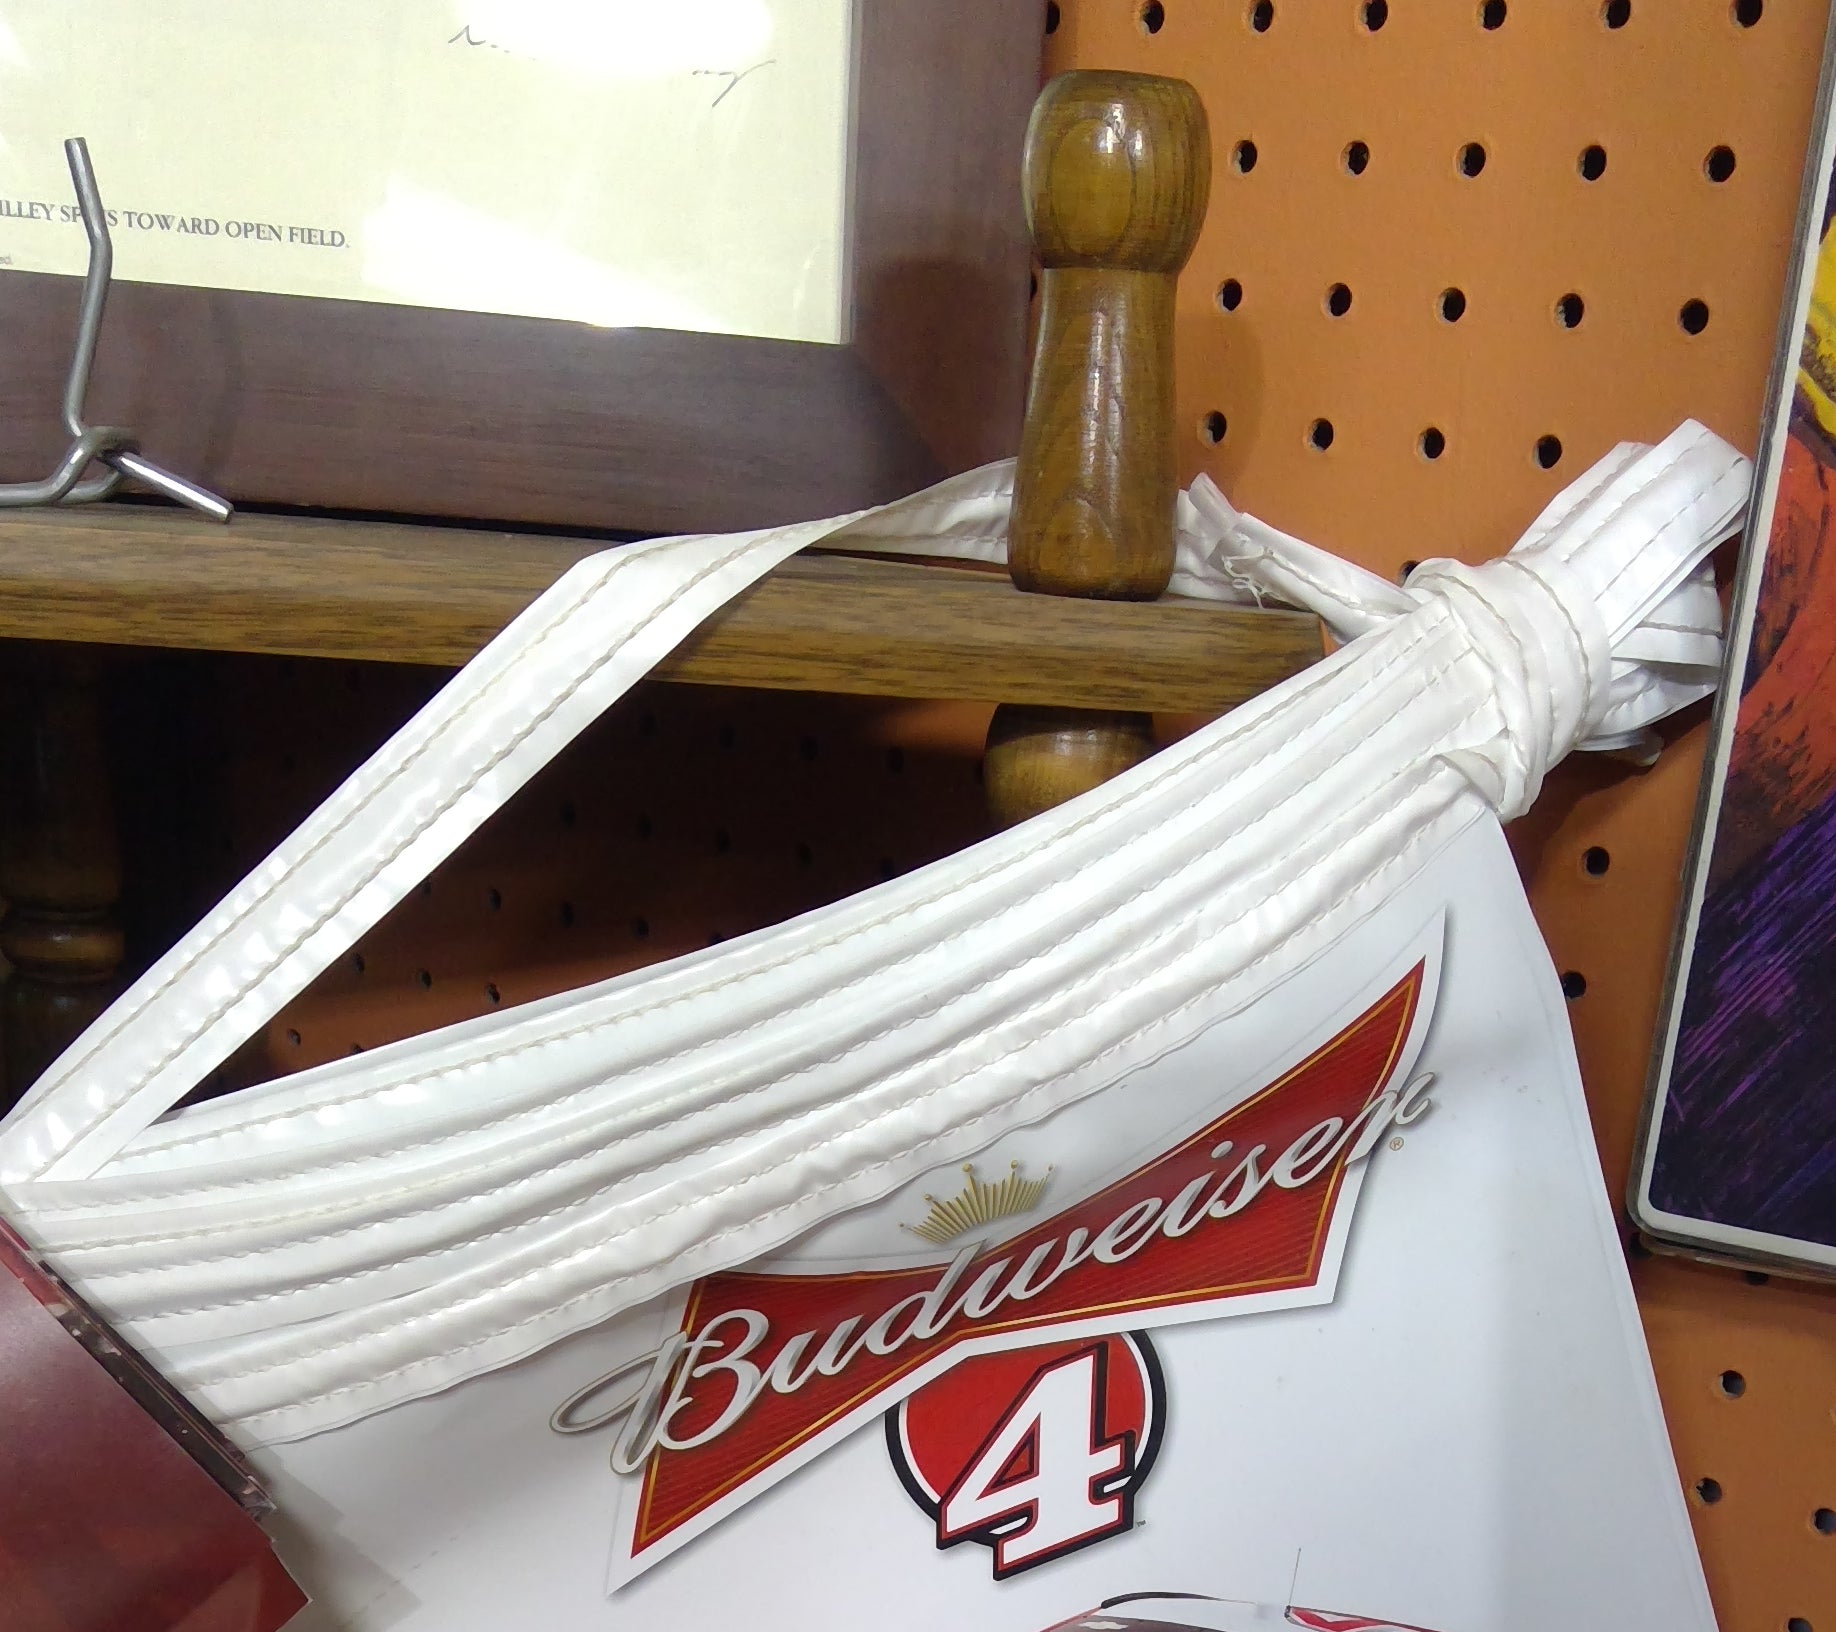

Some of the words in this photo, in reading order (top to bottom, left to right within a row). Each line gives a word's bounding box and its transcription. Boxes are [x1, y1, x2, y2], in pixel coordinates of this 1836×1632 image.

[60, 205, 118, 228] SPS
[123, 210, 220, 236] TOWARD
[225, 219, 283, 243] OPEN
[289, 226, 350, 249] FIELD.
[549, 1071, 1436, 1476] Budweiser
[936, 1338, 1137, 1582] 4
